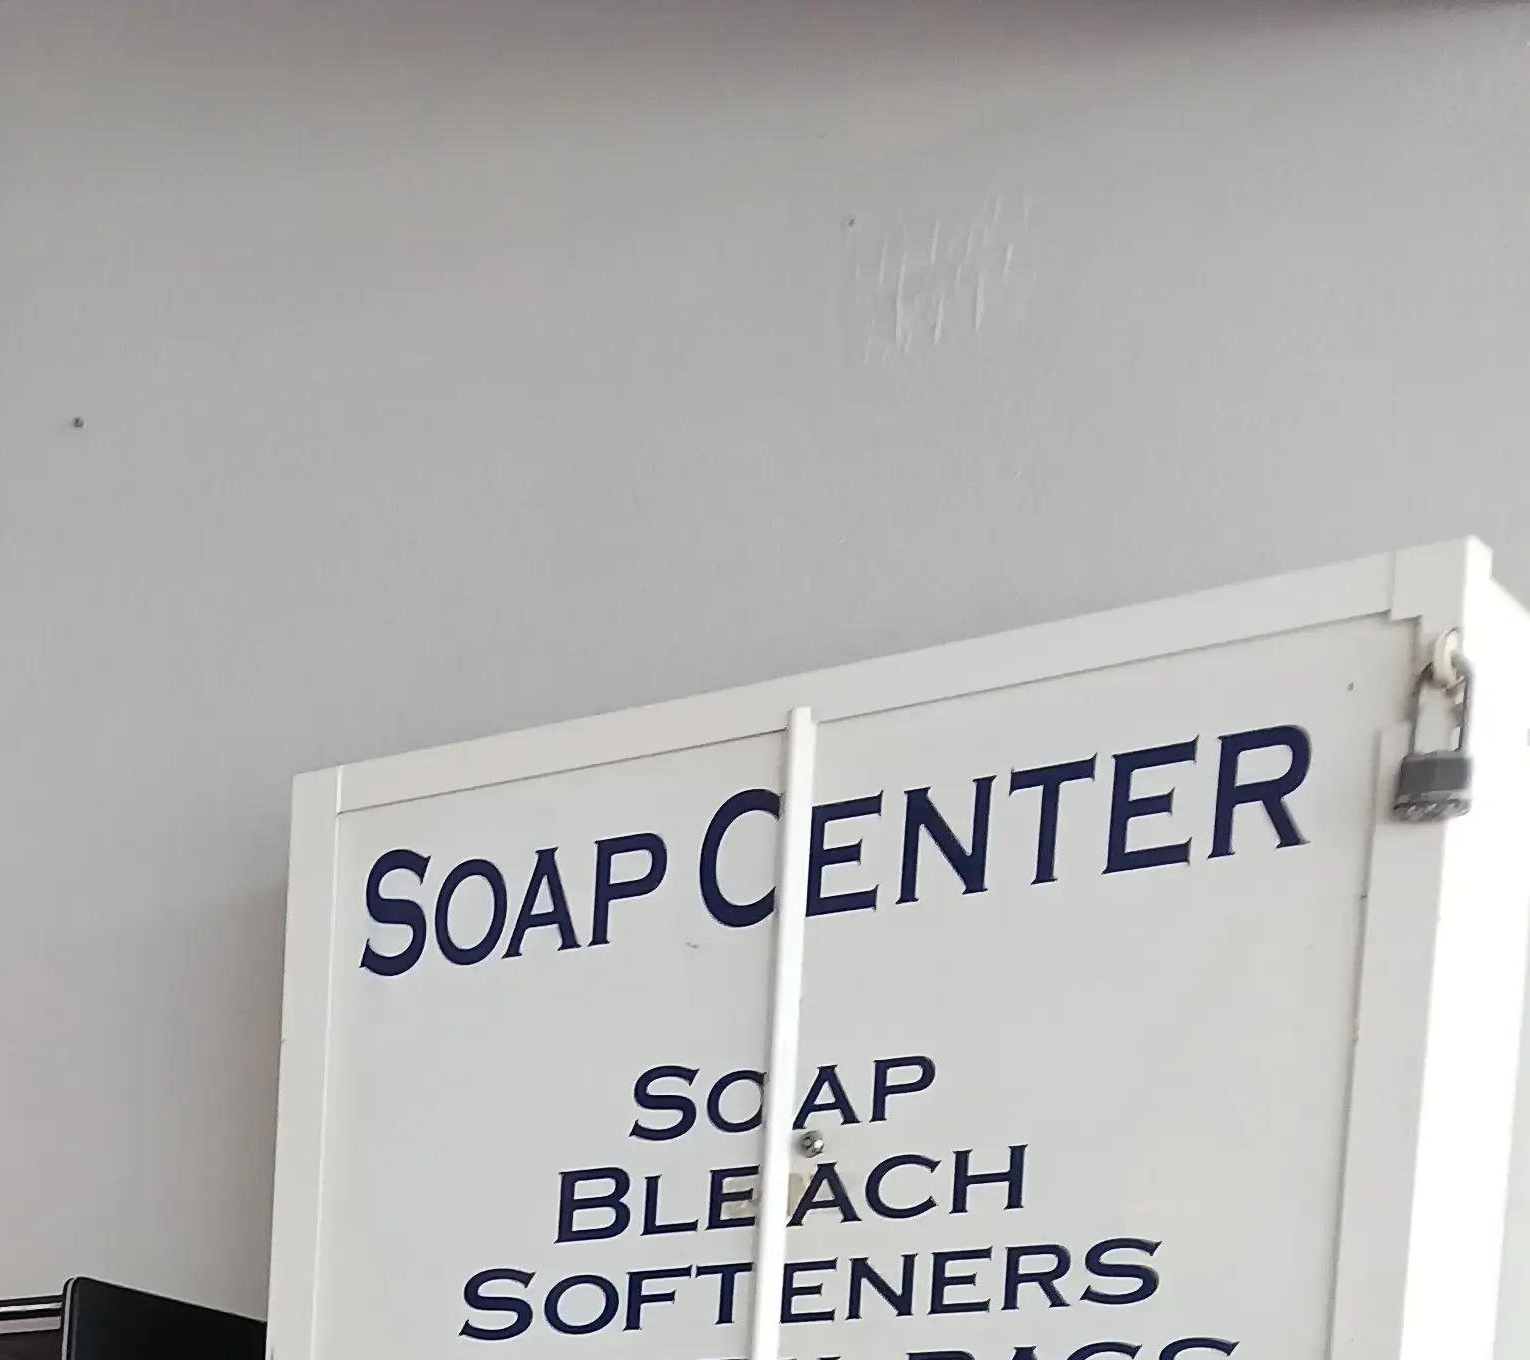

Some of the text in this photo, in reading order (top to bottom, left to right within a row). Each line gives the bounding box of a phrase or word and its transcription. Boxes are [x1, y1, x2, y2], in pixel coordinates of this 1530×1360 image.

[358, 724, 1311, 977] SOAP CENTER
[628, 1055, 936, 1143] SOAP
[553, 1143, 1029, 1244] BLEACH
[458, 1237, 1163, 1341] SOFTENERS
